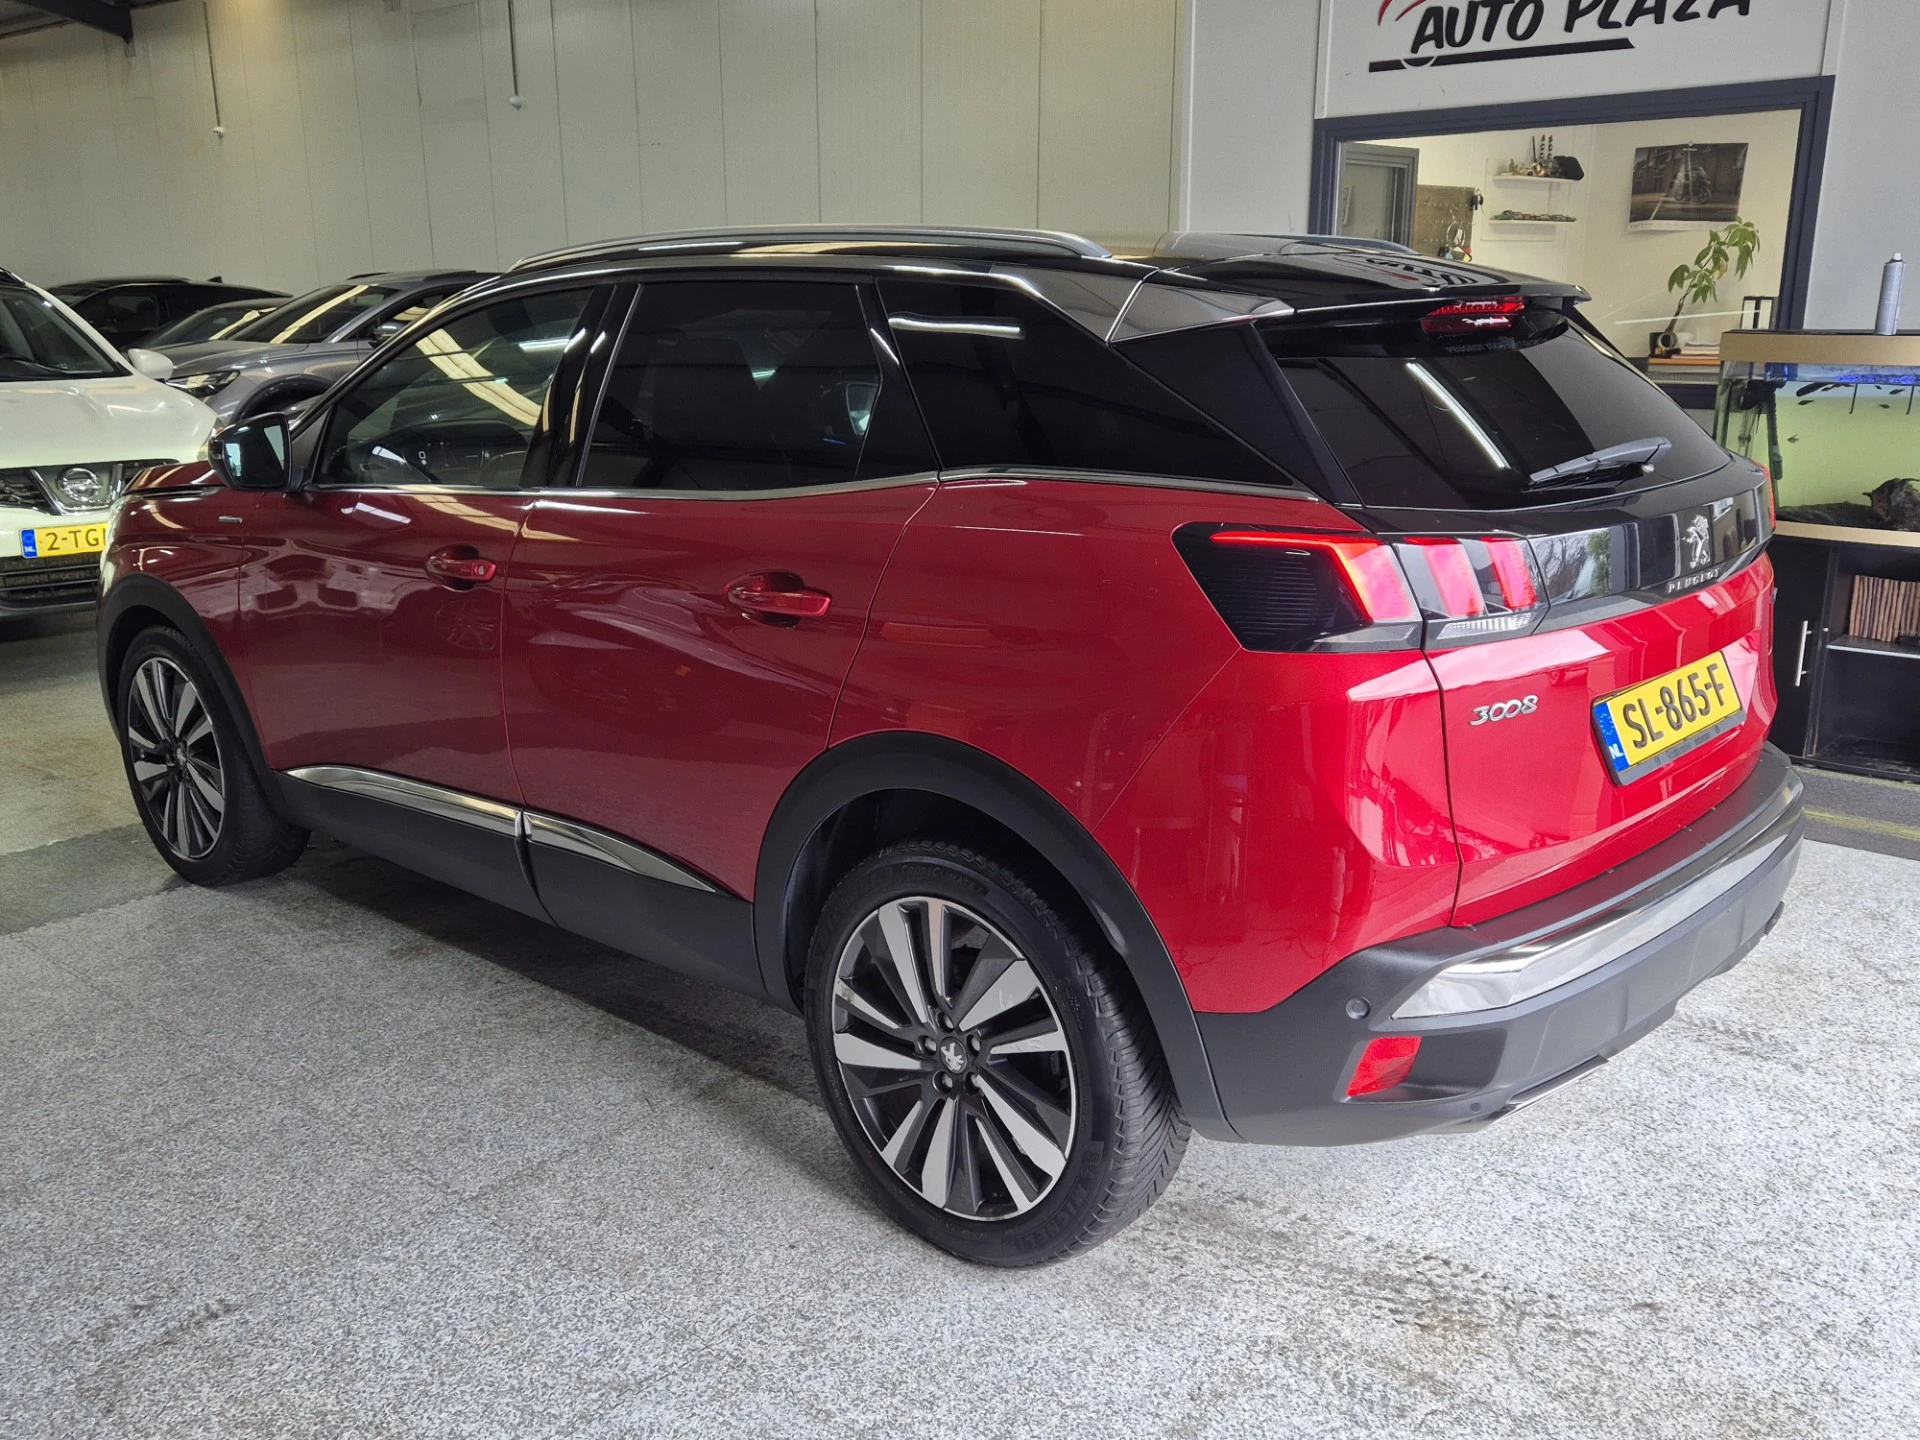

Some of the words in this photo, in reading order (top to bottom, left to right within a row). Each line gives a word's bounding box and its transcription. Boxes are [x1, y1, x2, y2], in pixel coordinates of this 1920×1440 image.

[1410, 0, 1544, 54] AUTO
[45, 528, 107, 551] 2-TG
[1467, 694, 1539, 726] 3008
[1623, 663, 1725, 749] SL-865-F
[1609, 745, 1624, 759] NL
